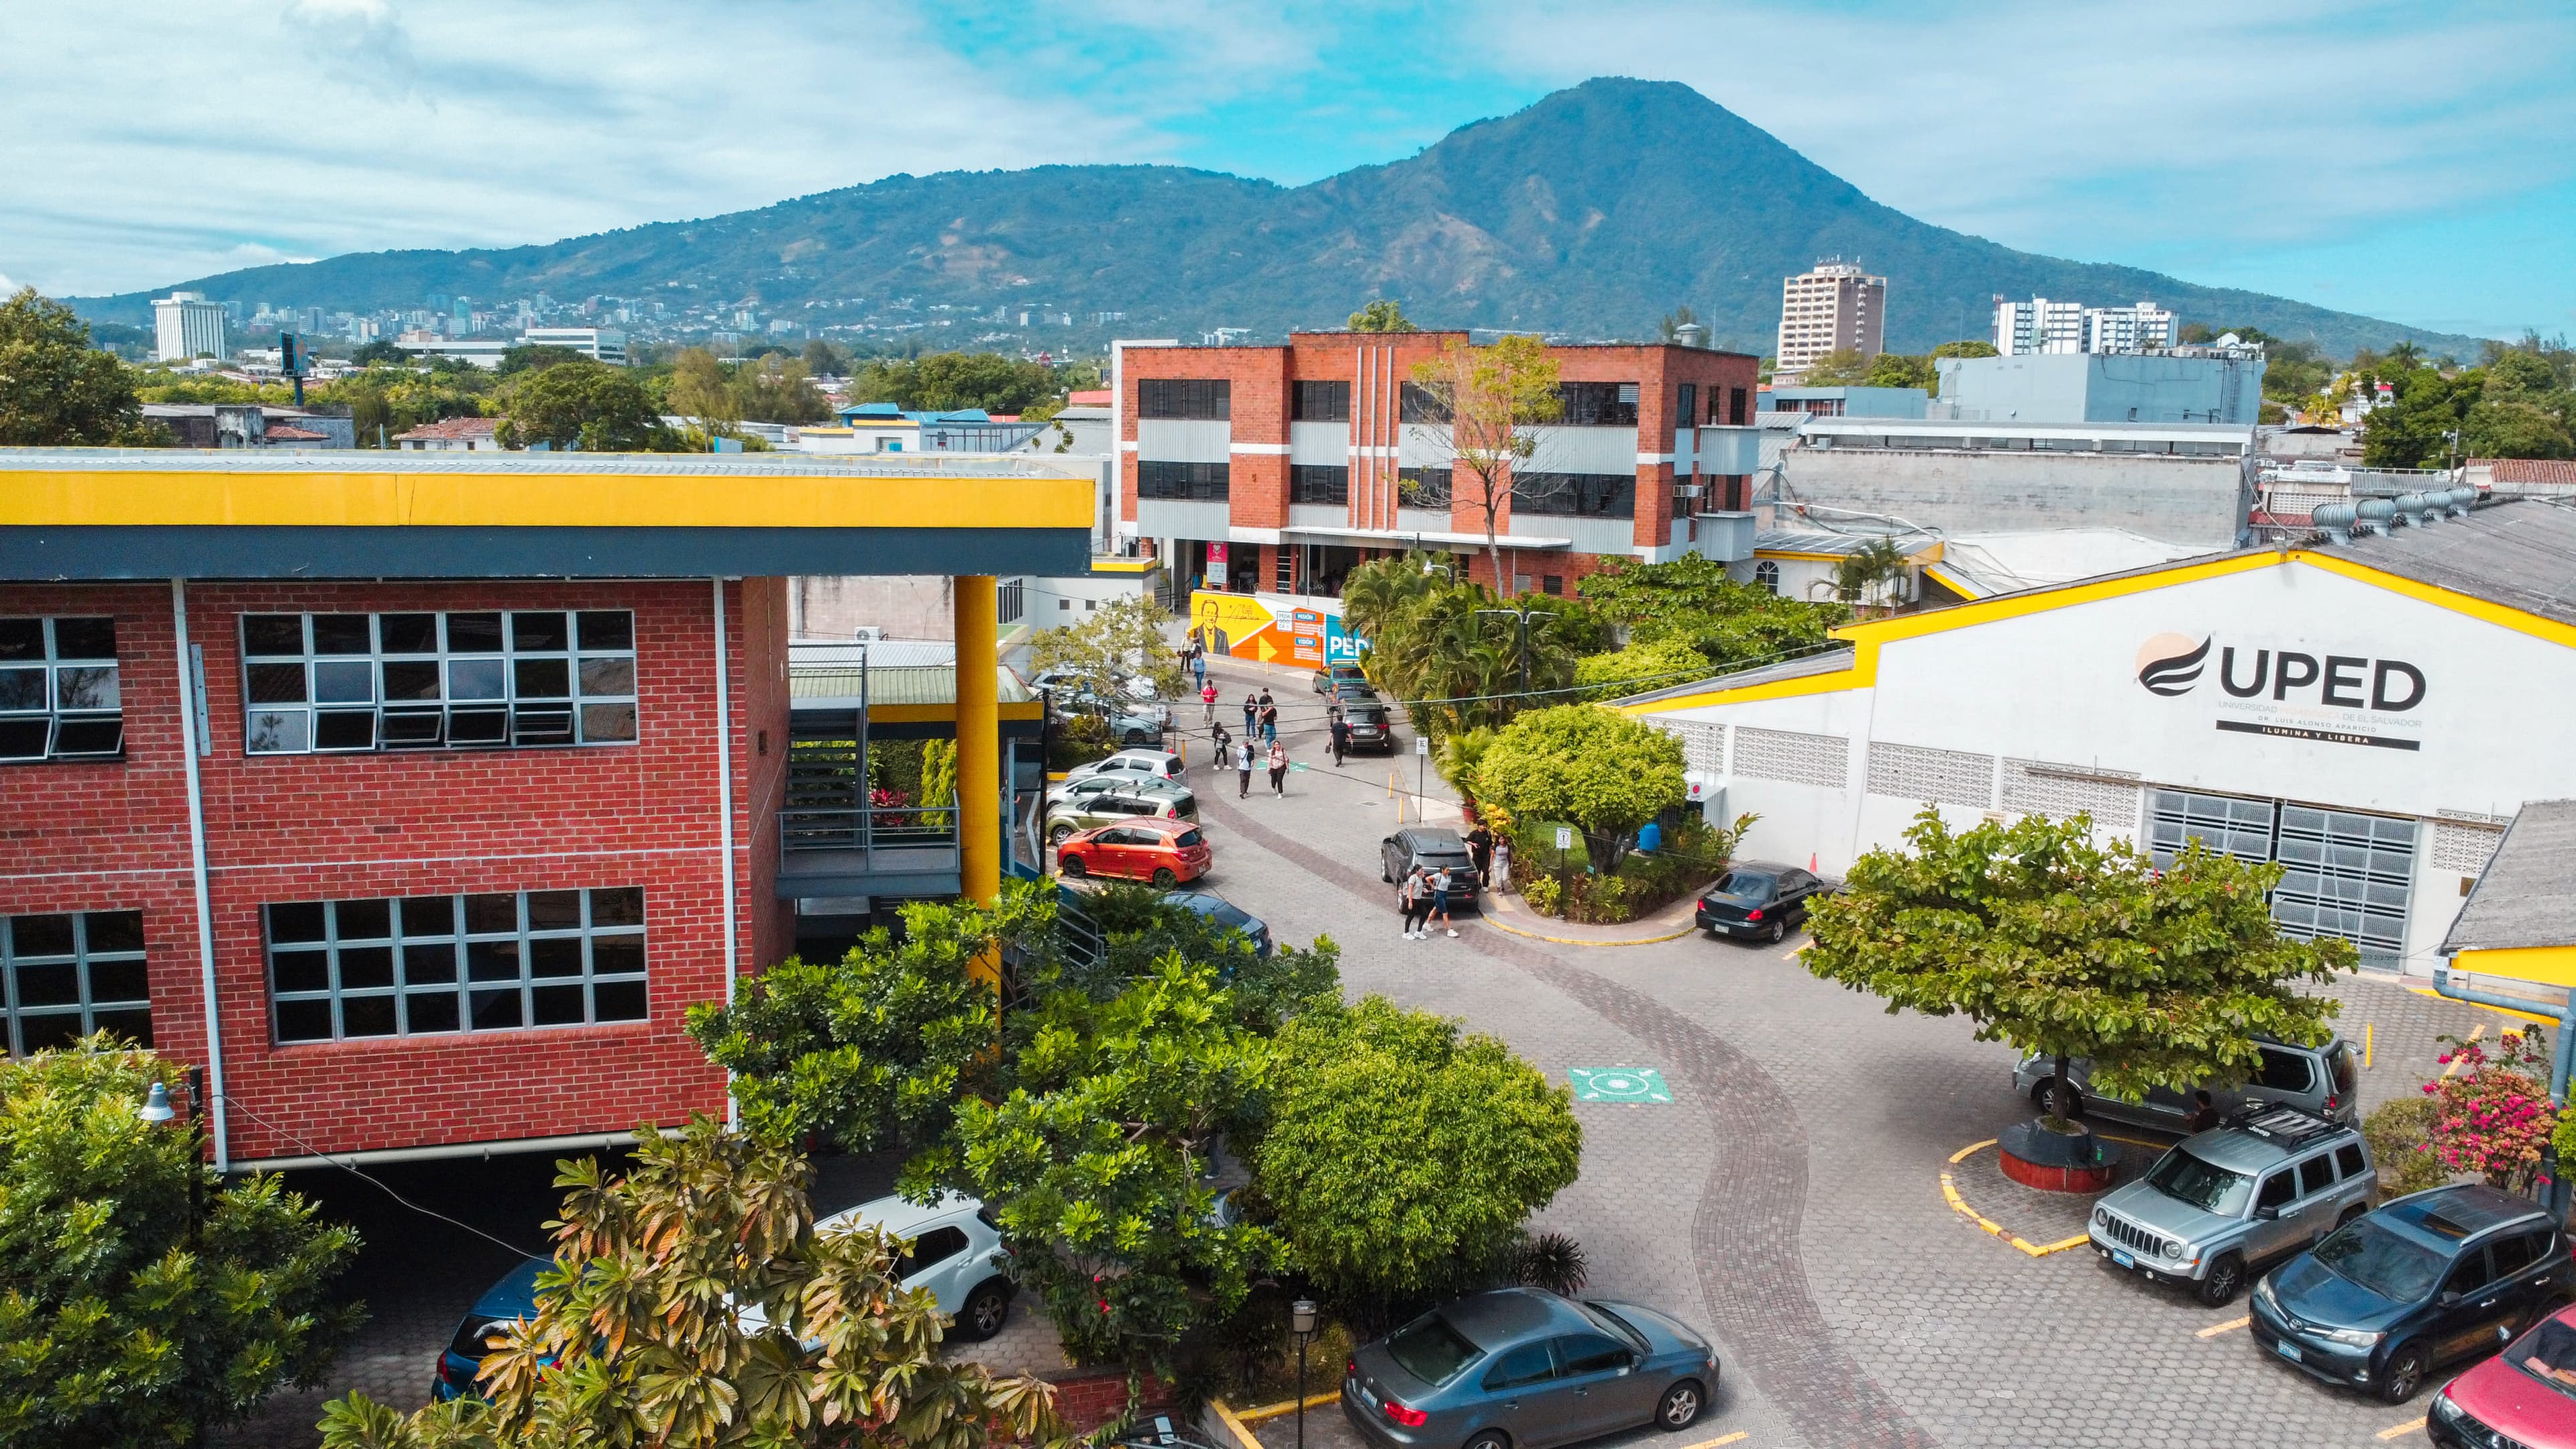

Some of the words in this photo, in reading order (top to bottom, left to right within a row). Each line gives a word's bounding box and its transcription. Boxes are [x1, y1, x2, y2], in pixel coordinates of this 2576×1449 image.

[1330, 636, 1376, 657] PED
[2220, 646, 2427, 712] UPED
[2218, 701, 2277, 713] UNIVERSIDAD
[2343, 713, 2355, 722] DE
[2357, 714, 2368, 722] EL
[2371, 716, 2422, 728] SALVADOR
[2262, 727, 2309, 737] ILUMINA
[2328, 733, 2369, 744] LIBERA
[2298, 720, 2332, 728] ALONSO
[2336, 724, 2377, 733] APARICIO
